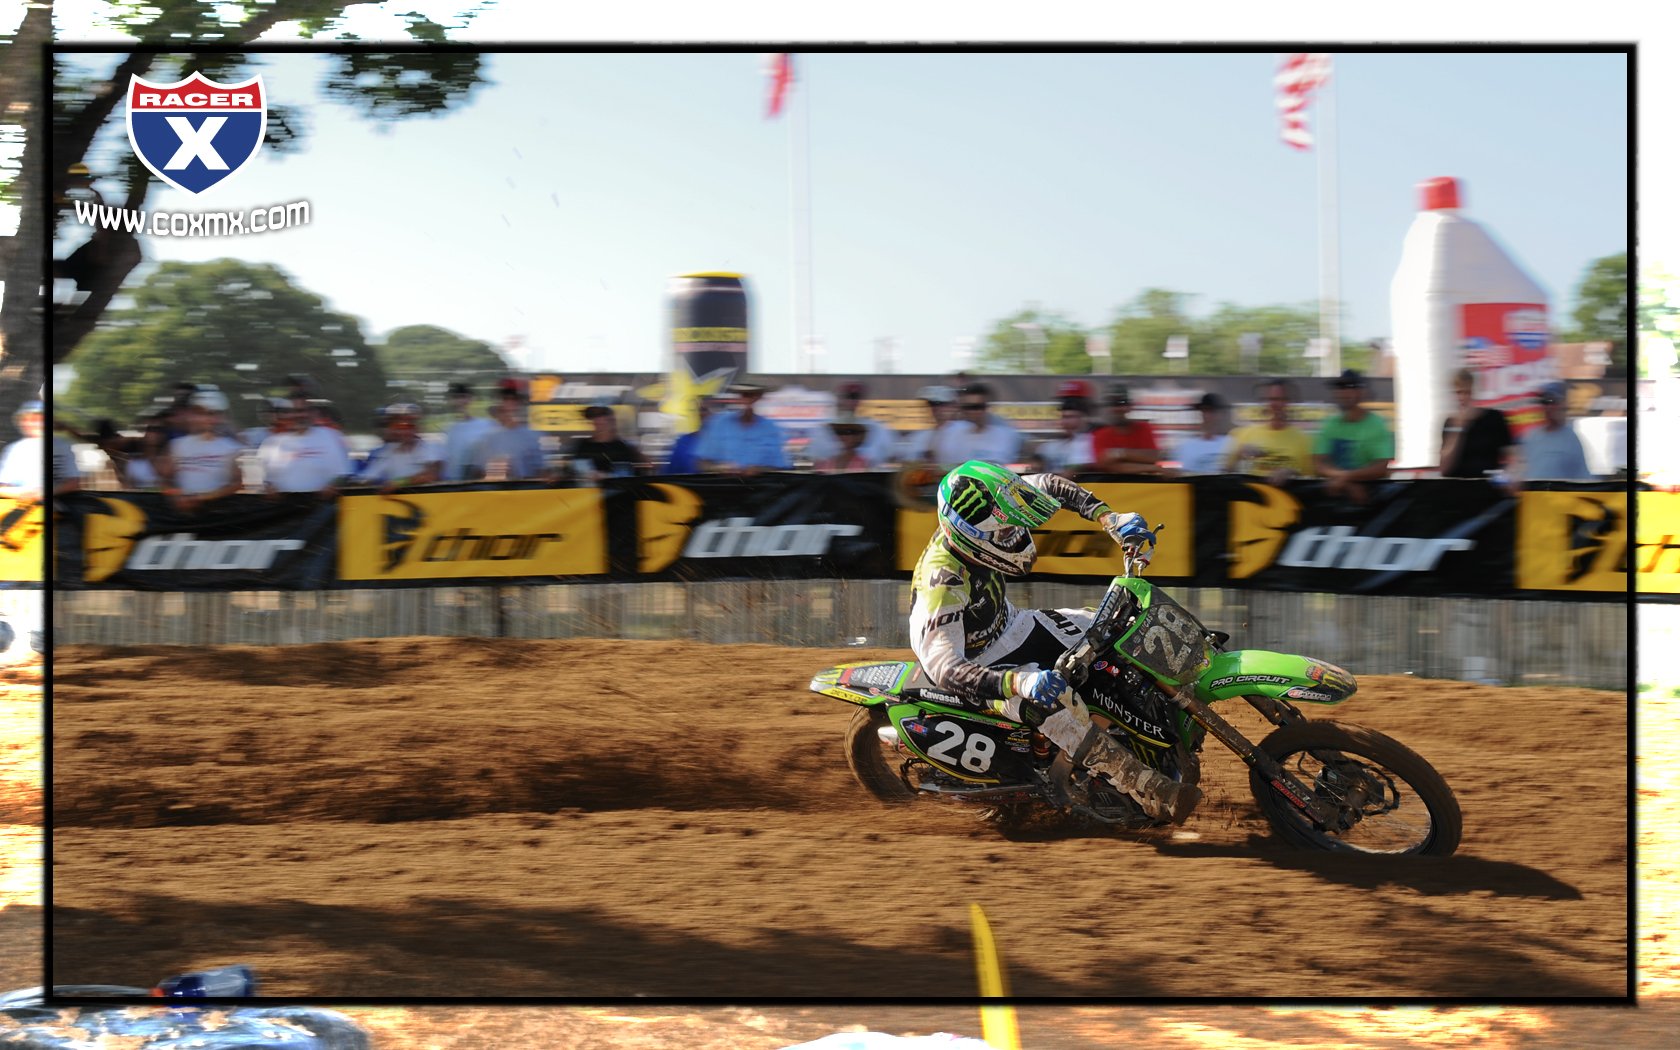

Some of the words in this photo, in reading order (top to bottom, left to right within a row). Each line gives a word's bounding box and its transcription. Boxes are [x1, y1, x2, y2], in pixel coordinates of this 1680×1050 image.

[125, 532, 307, 570] thor
[682, 517, 864, 558] thor
[1275, 525, 1476, 571] thor
[1143, 604, 1199, 675] 28
[919, 688, 963, 705] Kawasak
[1211, 676, 1233, 688] PRO
[1236, 675, 1290, 685] CIRCUIT
[1092, 688, 1165, 740] MONSTER
[927, 720, 996, 773] 28
